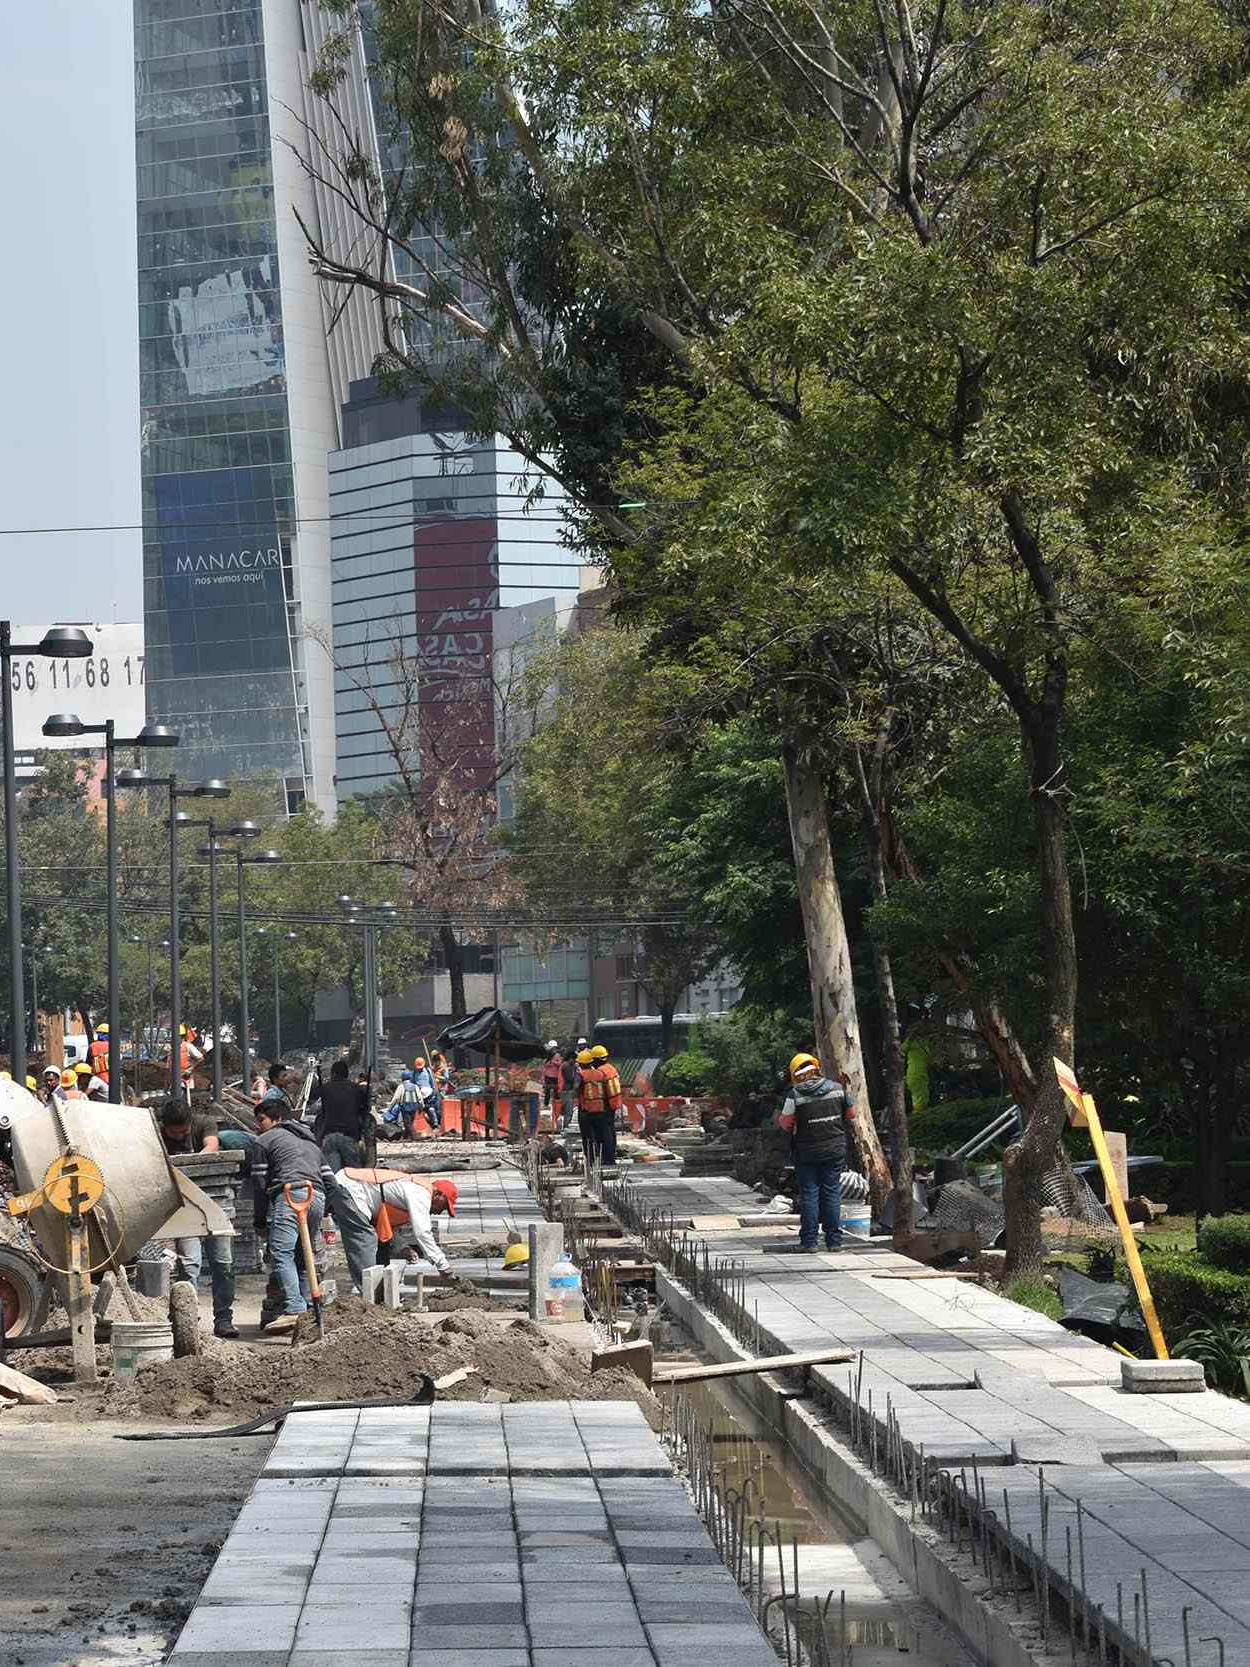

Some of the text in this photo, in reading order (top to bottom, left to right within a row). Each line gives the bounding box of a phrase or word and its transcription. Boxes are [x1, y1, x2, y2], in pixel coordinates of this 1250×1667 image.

[176, 548, 280, 573] MANACAR
[195, 576, 212, 585] nos
[214, 574, 241, 584] vemos
[12, 661, 36, 691] 56
[49, 659, 71, 689] 11
[86, 658, 110, 688] 68
